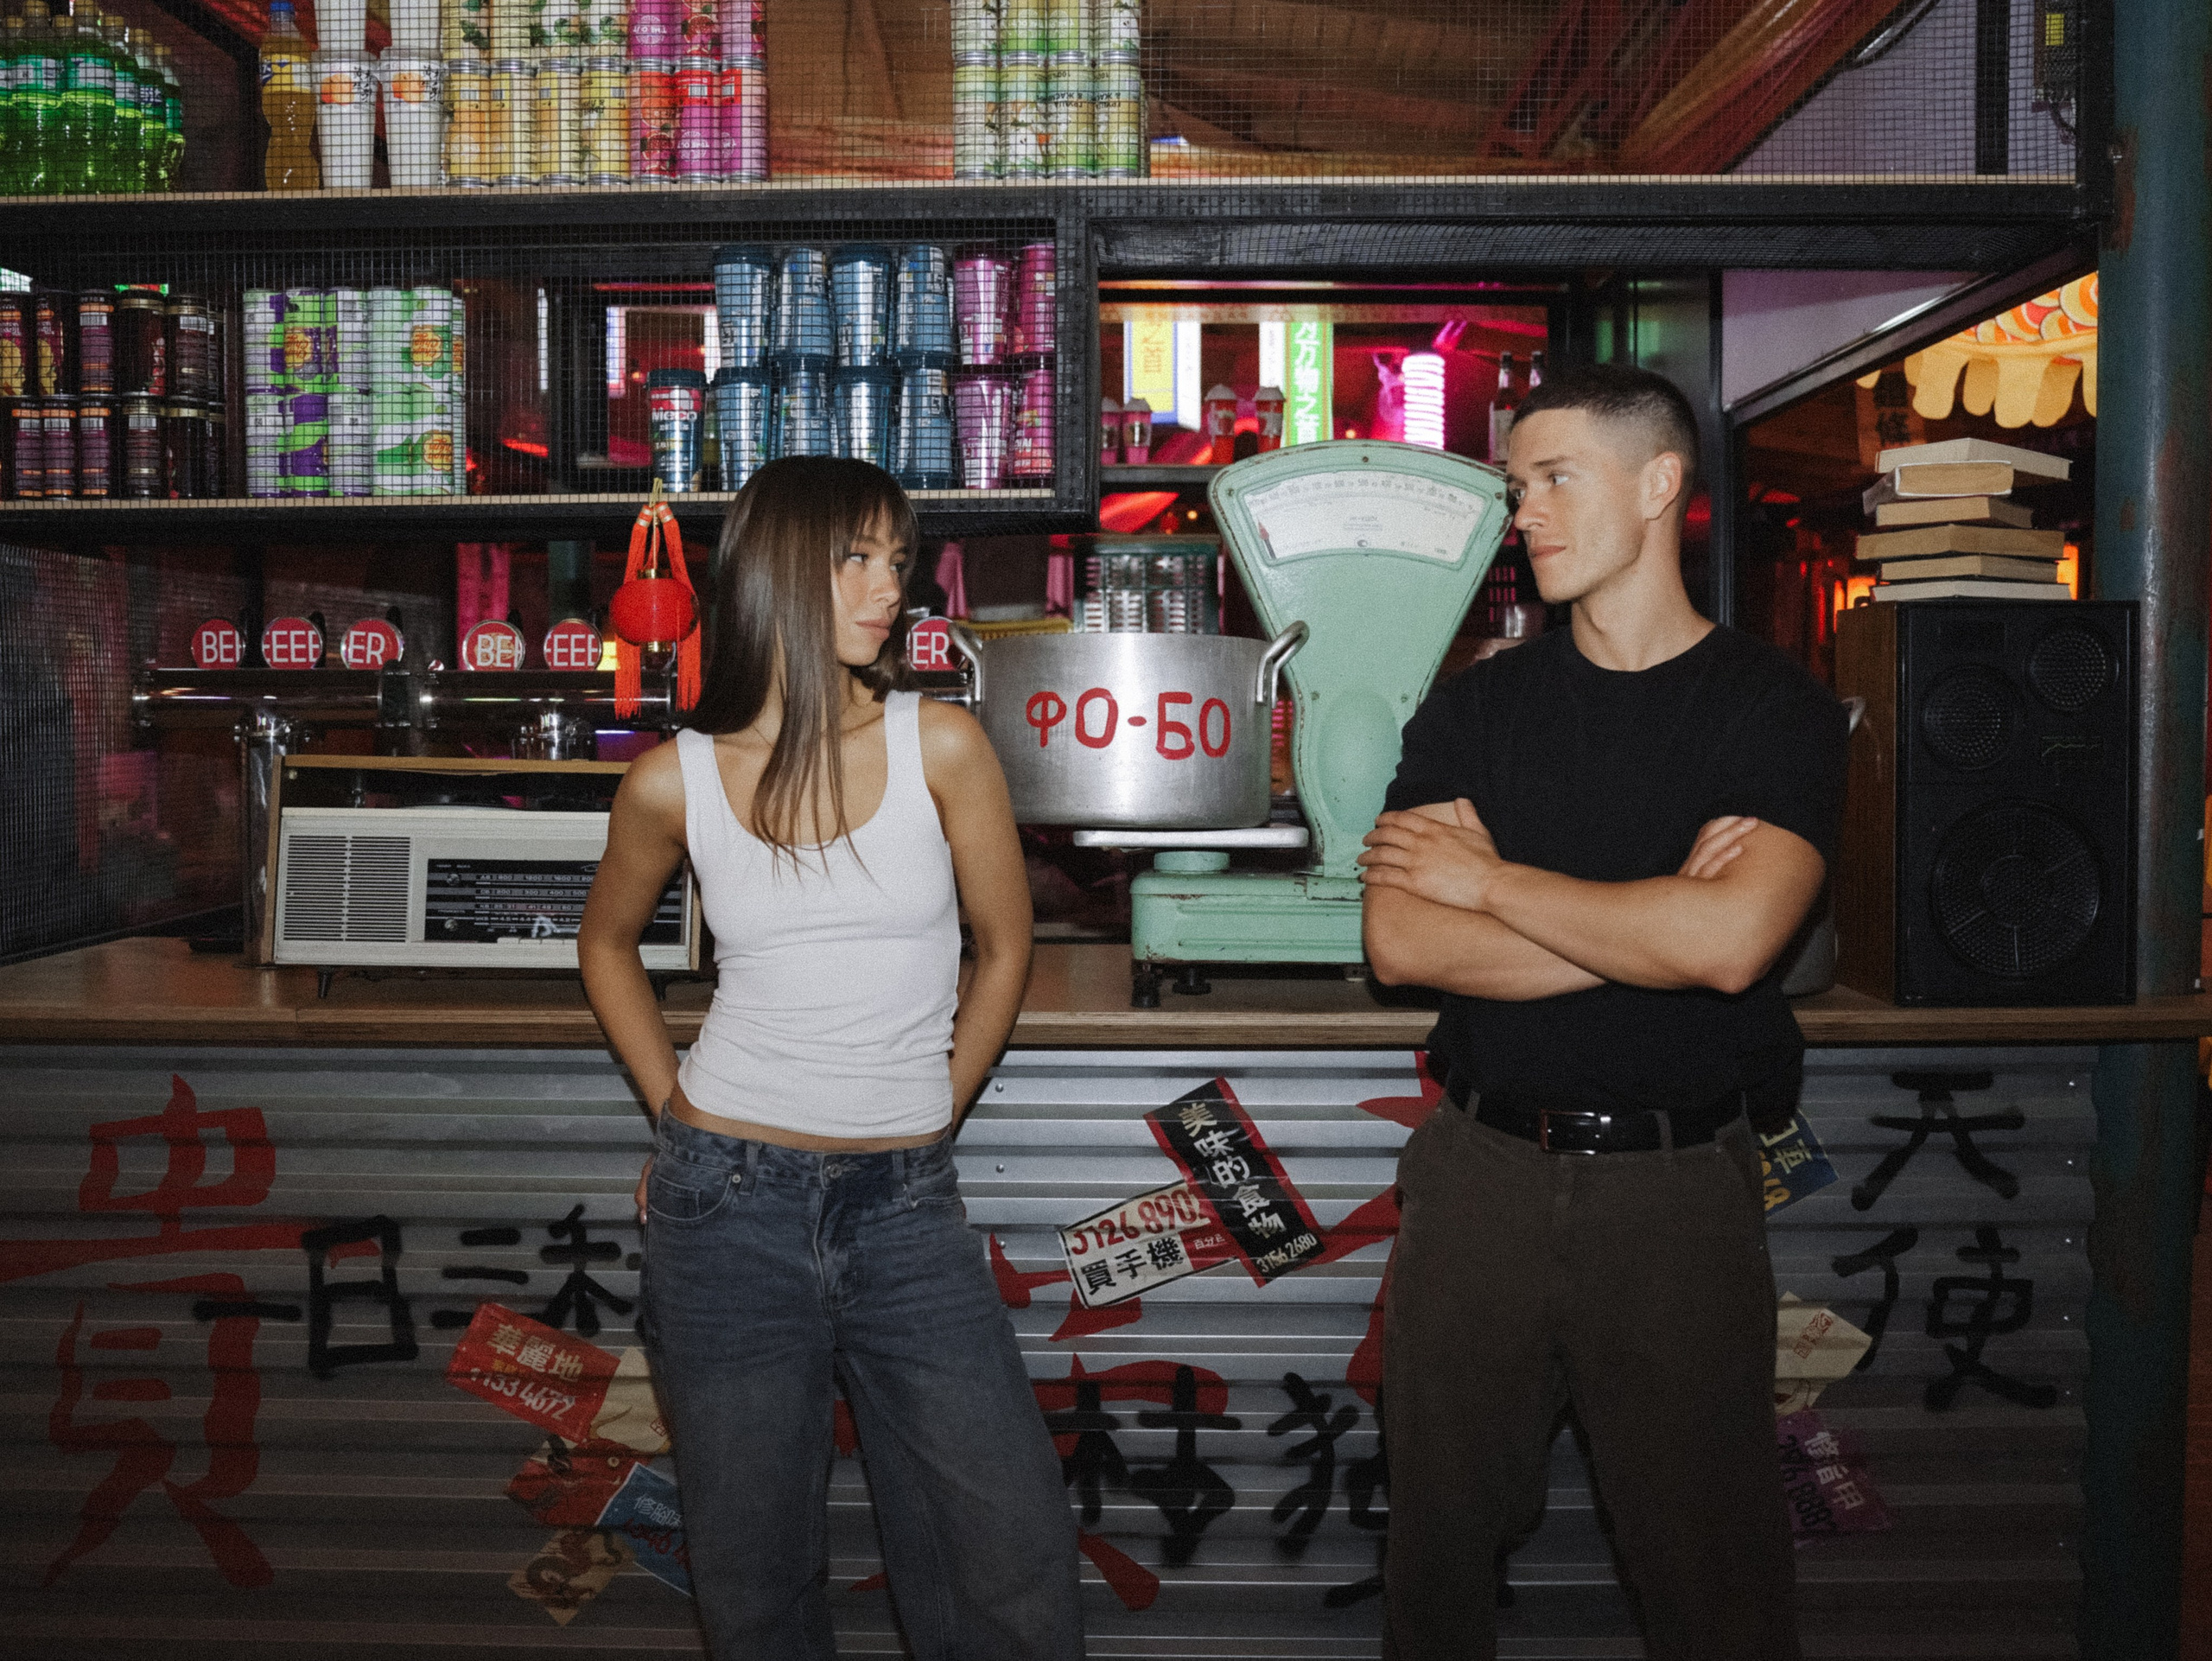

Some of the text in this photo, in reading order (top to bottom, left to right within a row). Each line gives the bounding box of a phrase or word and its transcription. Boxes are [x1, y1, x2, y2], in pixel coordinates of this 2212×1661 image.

[347, 630, 385, 665] ER
[912, 631, 950, 665] ER
[1026, 687, 1231, 760] ФО-БО
[1179, 1101, 1287, 1239] 美味的食物
[1081, 1236, 1185, 1295] 買手機
[1255, 1232, 1318, 1274] 3156 2680
[486, 1323, 585, 1383] 華麗地
